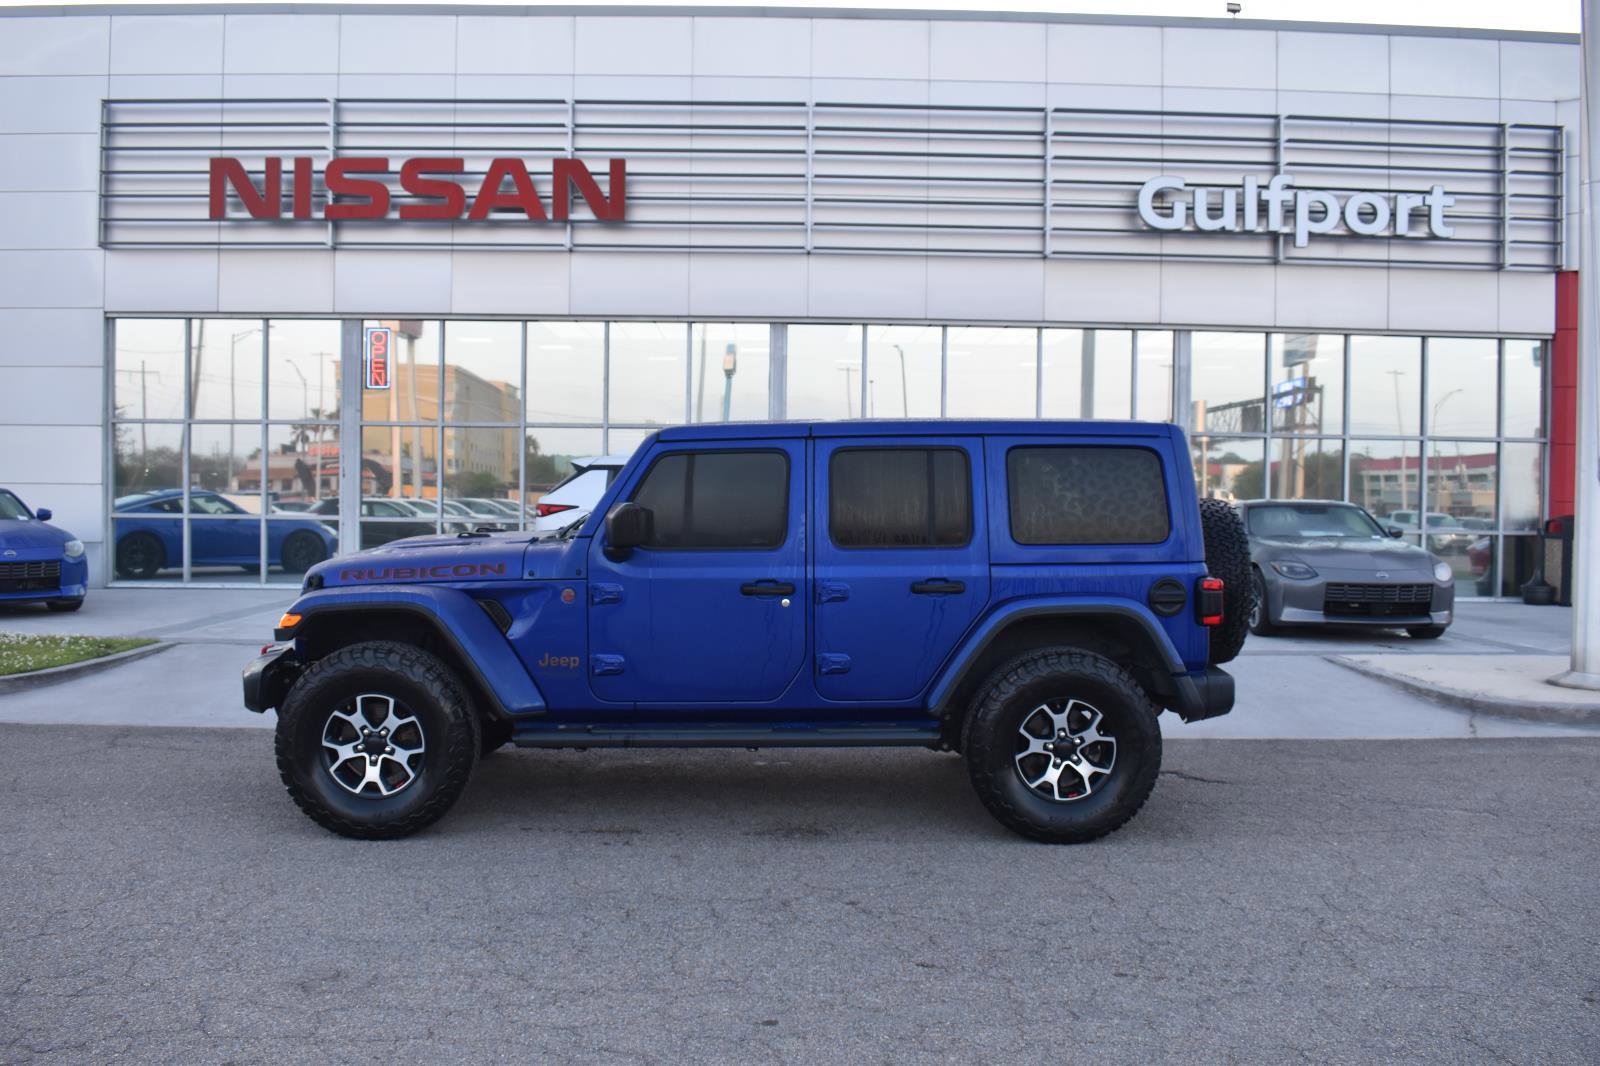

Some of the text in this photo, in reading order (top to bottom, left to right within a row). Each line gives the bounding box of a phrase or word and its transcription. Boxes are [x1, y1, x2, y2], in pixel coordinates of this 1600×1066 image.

[209, 157, 626, 220] NISSAN
[1138, 174, 1455, 248] Gulfport
[371, 331, 386, 387] OPEN
[340, 563, 506, 581] RUBICON
[537, 652, 580, 670] Jeep
